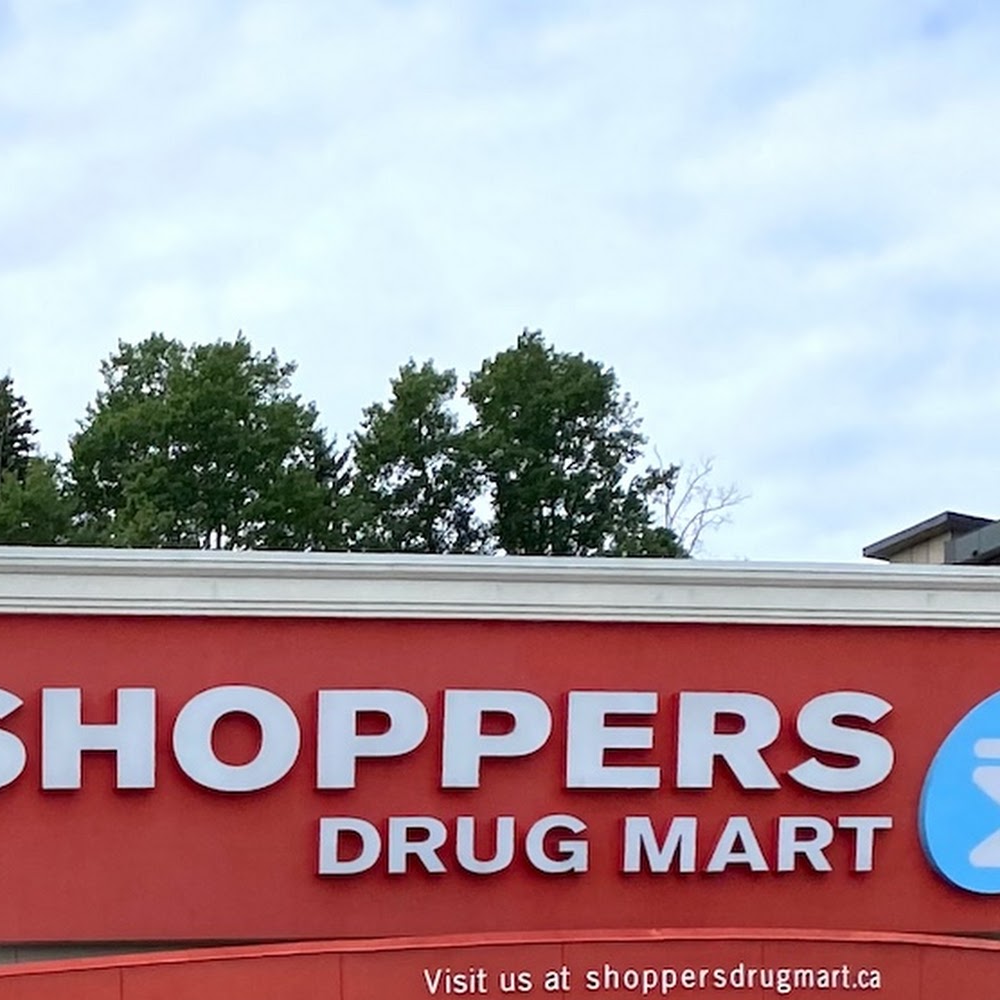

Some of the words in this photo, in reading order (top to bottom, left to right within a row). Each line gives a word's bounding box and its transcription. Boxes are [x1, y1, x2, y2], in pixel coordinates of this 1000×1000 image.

[317, 814, 588, 876] DRUG
[622, 815, 893, 874] MART
[423, 968, 487, 994] Visit
[500, 971, 533, 992] us
[544, 965, 571, 991] at
[586, 963, 882, 995] shoppersdrugmart.ca
